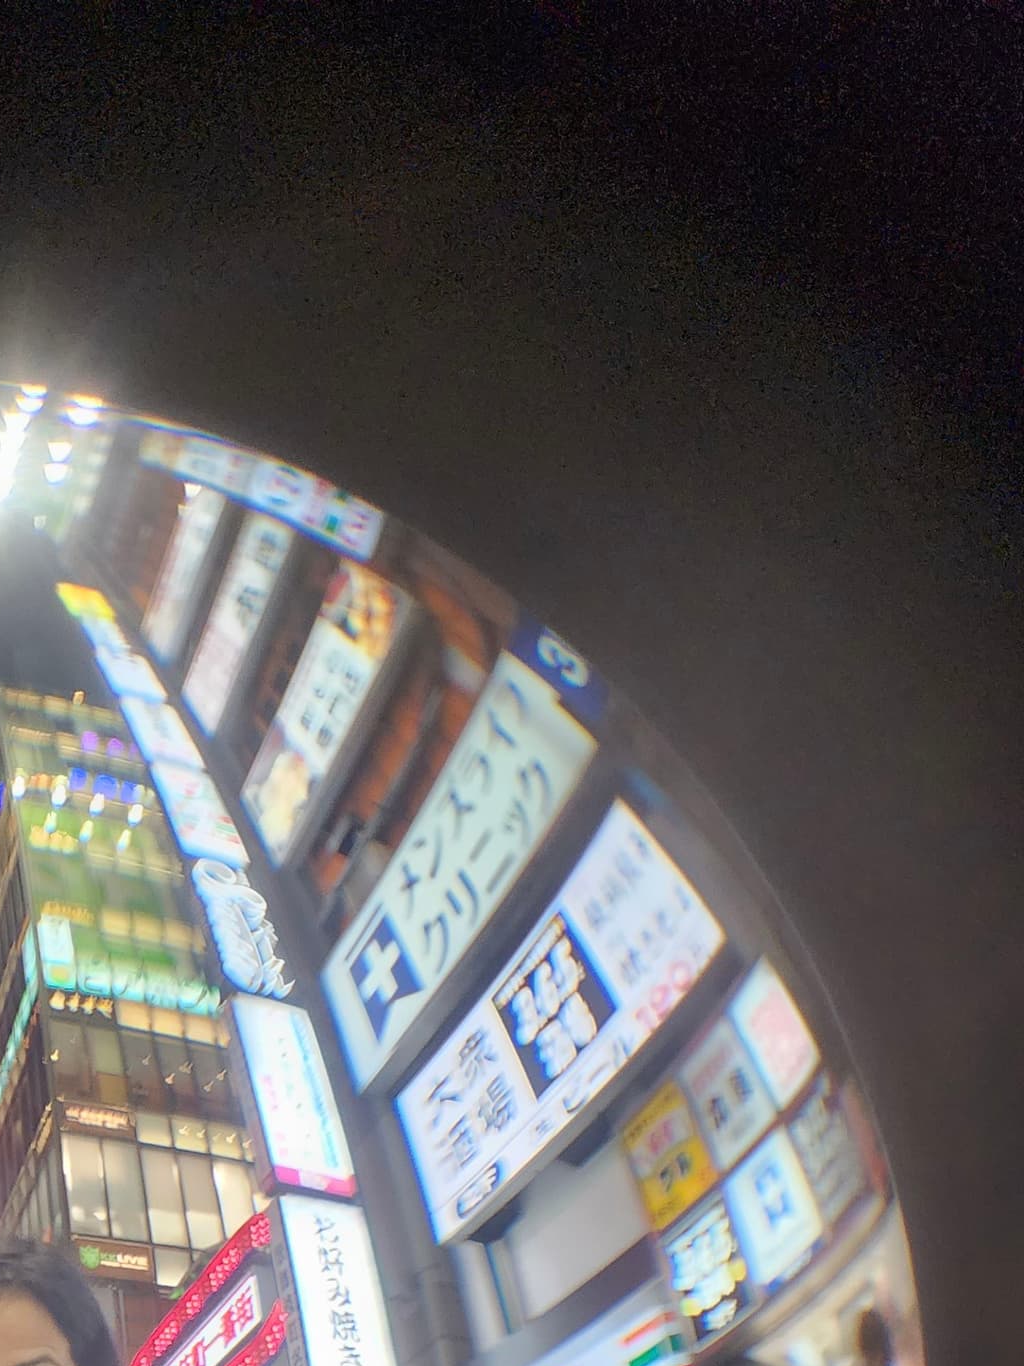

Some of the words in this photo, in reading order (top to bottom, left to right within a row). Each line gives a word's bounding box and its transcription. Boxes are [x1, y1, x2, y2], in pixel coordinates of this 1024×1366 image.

[422, 759, 554, 976] クリニック
[424, 1026, 500, 1131] 大衆
[436, 1072, 519, 1177] 酒場
